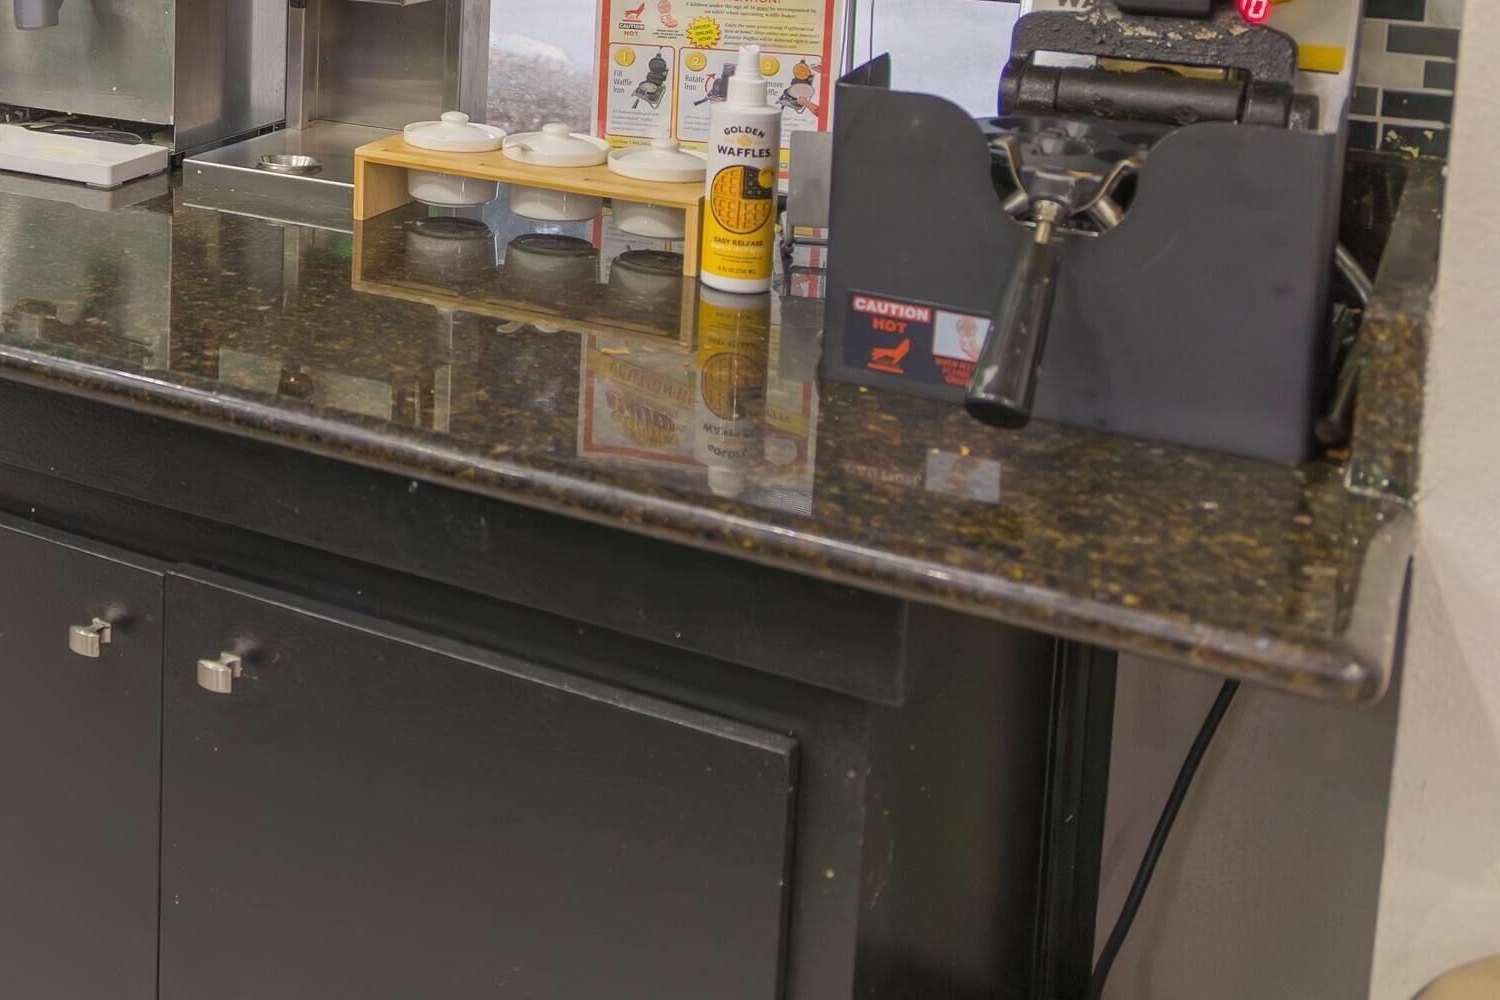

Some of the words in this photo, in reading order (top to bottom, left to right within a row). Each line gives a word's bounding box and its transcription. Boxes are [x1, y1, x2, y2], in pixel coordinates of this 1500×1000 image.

[623, 53, 628, 62] 1
[693, 57, 701, 66] 2
[613, 78, 633, 87] Waffle
[684, 74, 705, 83] Rotate
[613, 86, 625, 94] Iron
[684, 83, 697, 91] Iron
[766, 88, 779, 97] ffle
[724, 125, 766, 139] GOLDEN
[717, 144, 772, 158] WAFFLES
[714, 236, 731, 245] EASY
[854, 297, 929, 322] CAUTION
[871, 318, 908, 334] HOT
